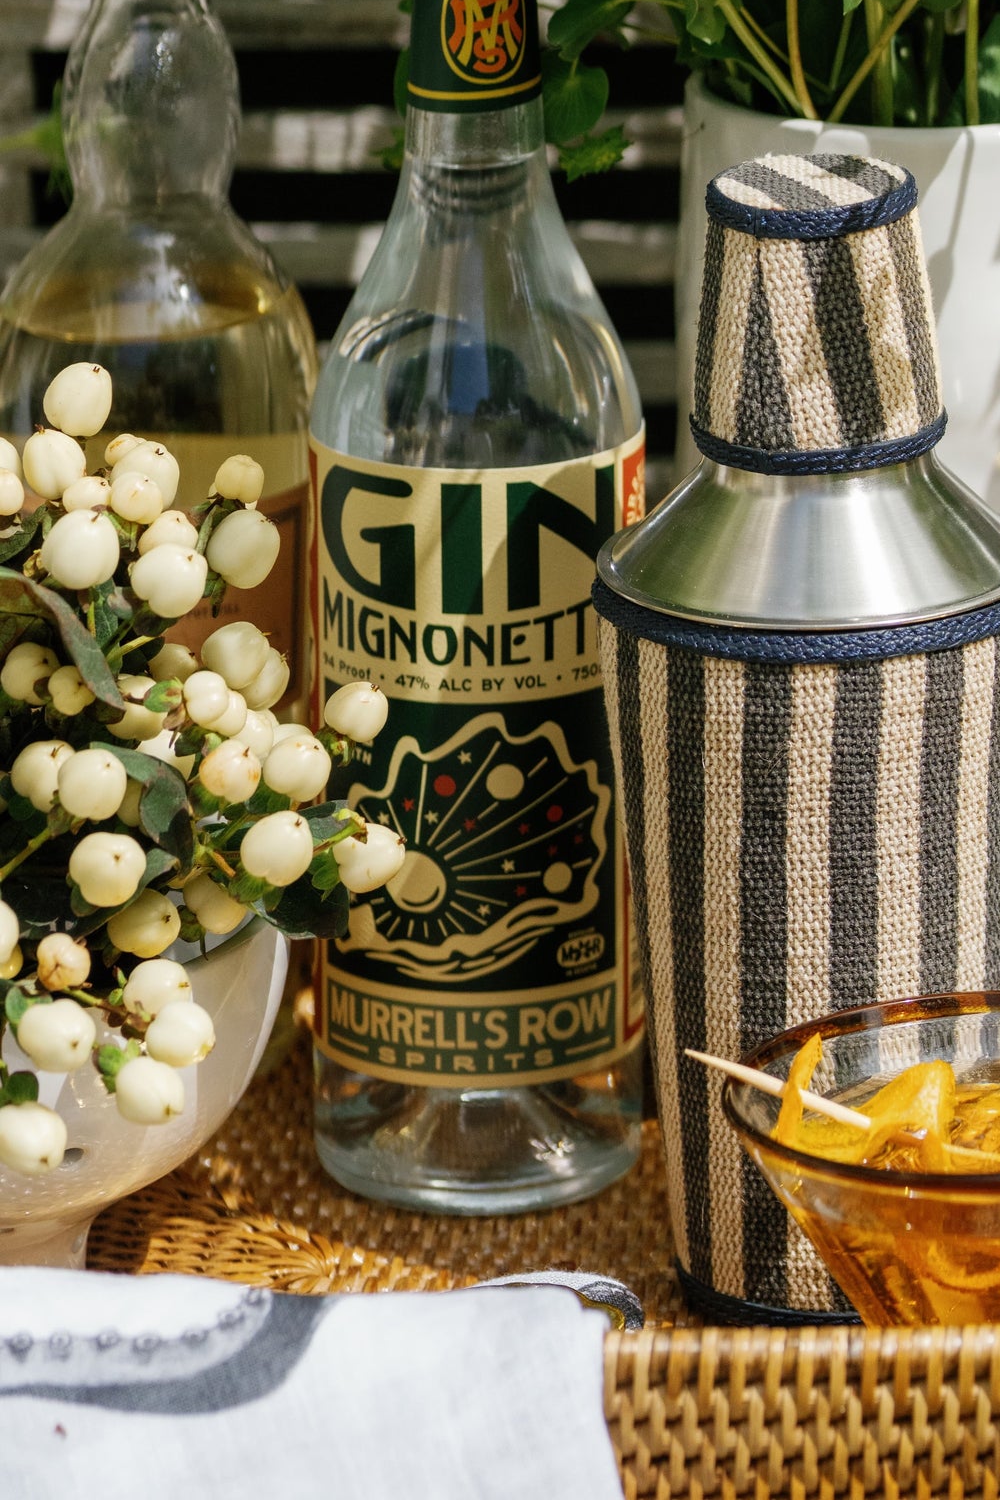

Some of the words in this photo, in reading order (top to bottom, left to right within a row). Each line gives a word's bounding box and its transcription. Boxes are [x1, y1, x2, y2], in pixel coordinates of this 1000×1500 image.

[320, 463, 616, 616] GIN
[323, 575, 600, 668] MIGNONETT
[339, 660, 372, 680] Proof
[394, 674, 430, 690] 47%
[438, 678, 472, 692] ALC
[482, 677, 506, 691] BY
[513, 675, 546, 689] VOL
[571, 662, 601, 682] 750
[330, 985, 509, 1050] MURRELL'S
[519, 987, 613, 1047] ROW
[378, 1049, 554, 1073] SPIRITS
